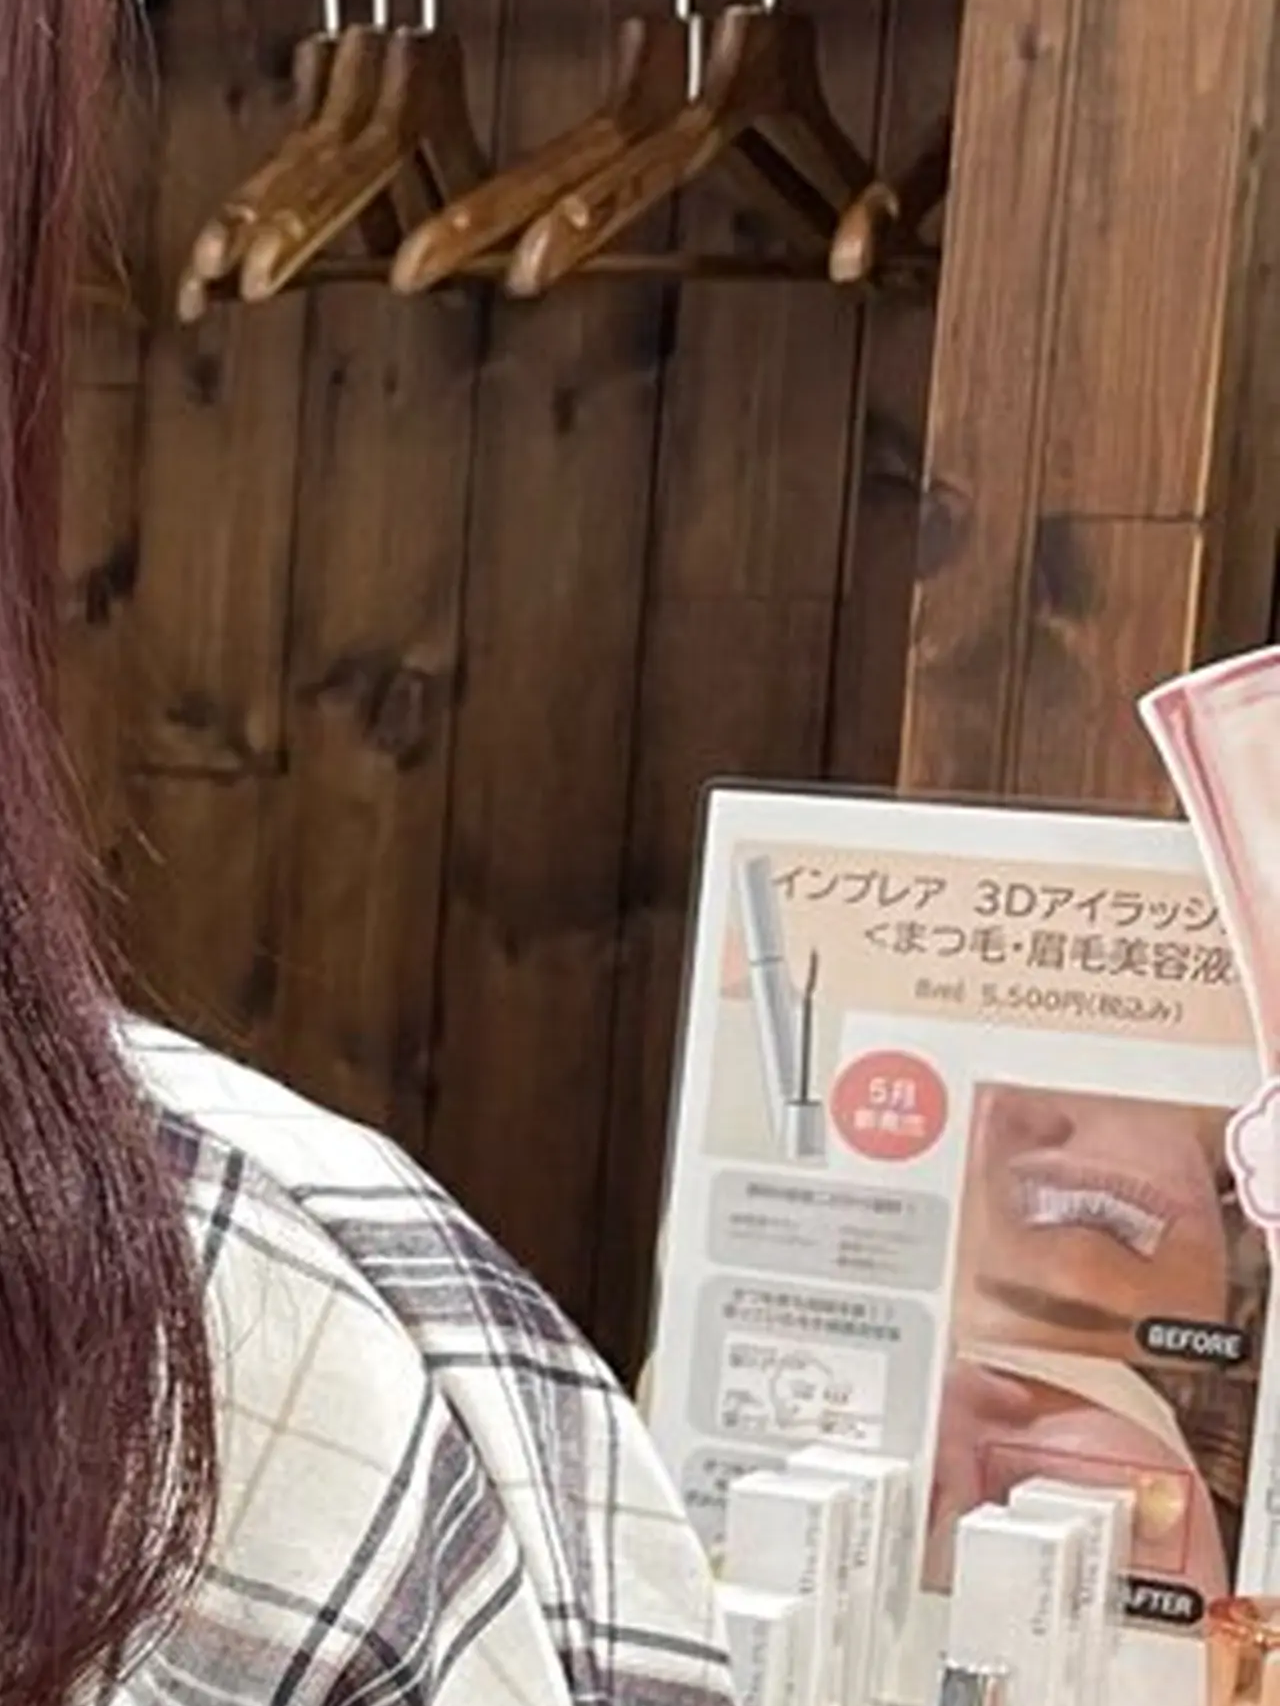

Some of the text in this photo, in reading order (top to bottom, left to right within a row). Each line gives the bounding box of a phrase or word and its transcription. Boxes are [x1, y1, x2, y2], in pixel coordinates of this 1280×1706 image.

[973, 878, 1228, 935] 3Dアイラッシ
[1147, 1324, 1242, 1360] BEFORE
